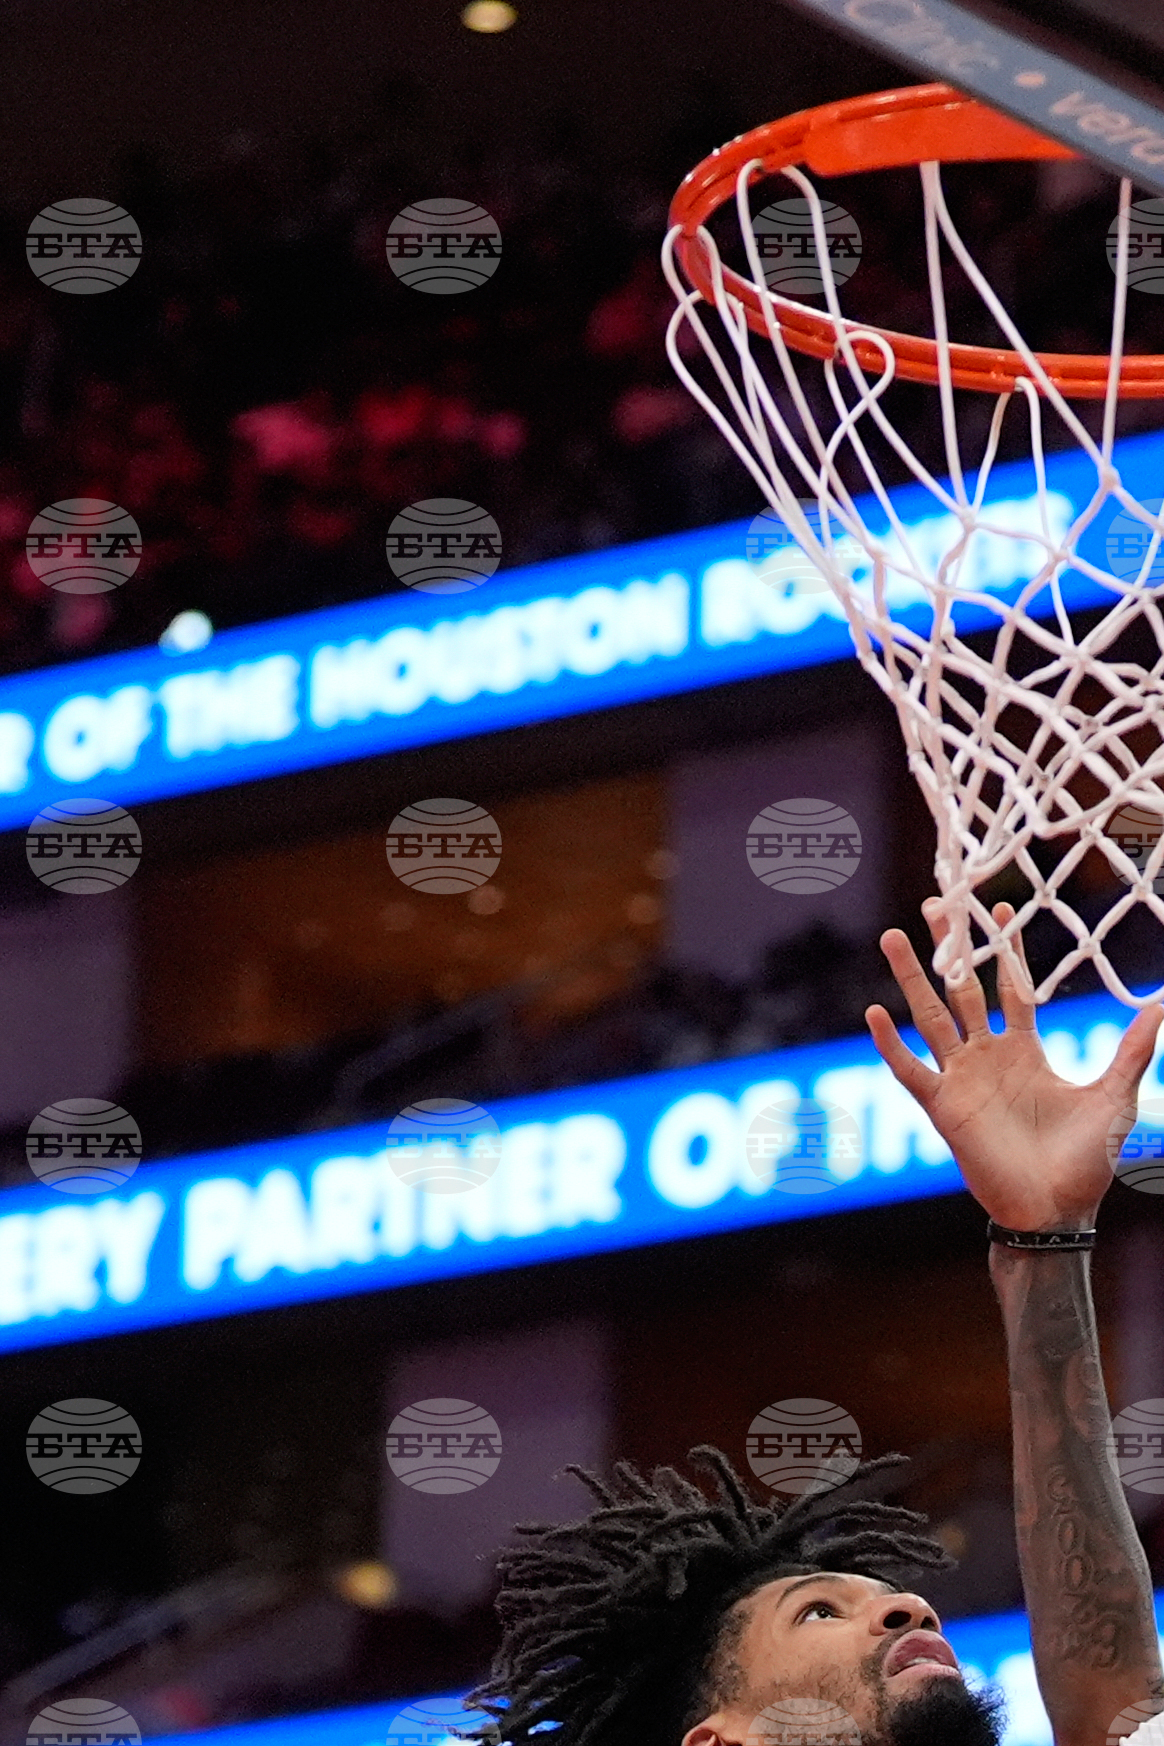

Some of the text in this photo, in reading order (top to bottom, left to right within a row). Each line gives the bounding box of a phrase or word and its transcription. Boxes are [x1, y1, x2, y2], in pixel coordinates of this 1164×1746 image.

[43, 684, 152, 783] OF
[157, 654, 300, 762] THE
[310, 572, 690, 730] HOUSTON
[182, 1112, 628, 1292] PARTNER
[648, 1078, 799, 1210] OF
[813, 1055, 958, 1182] TH
